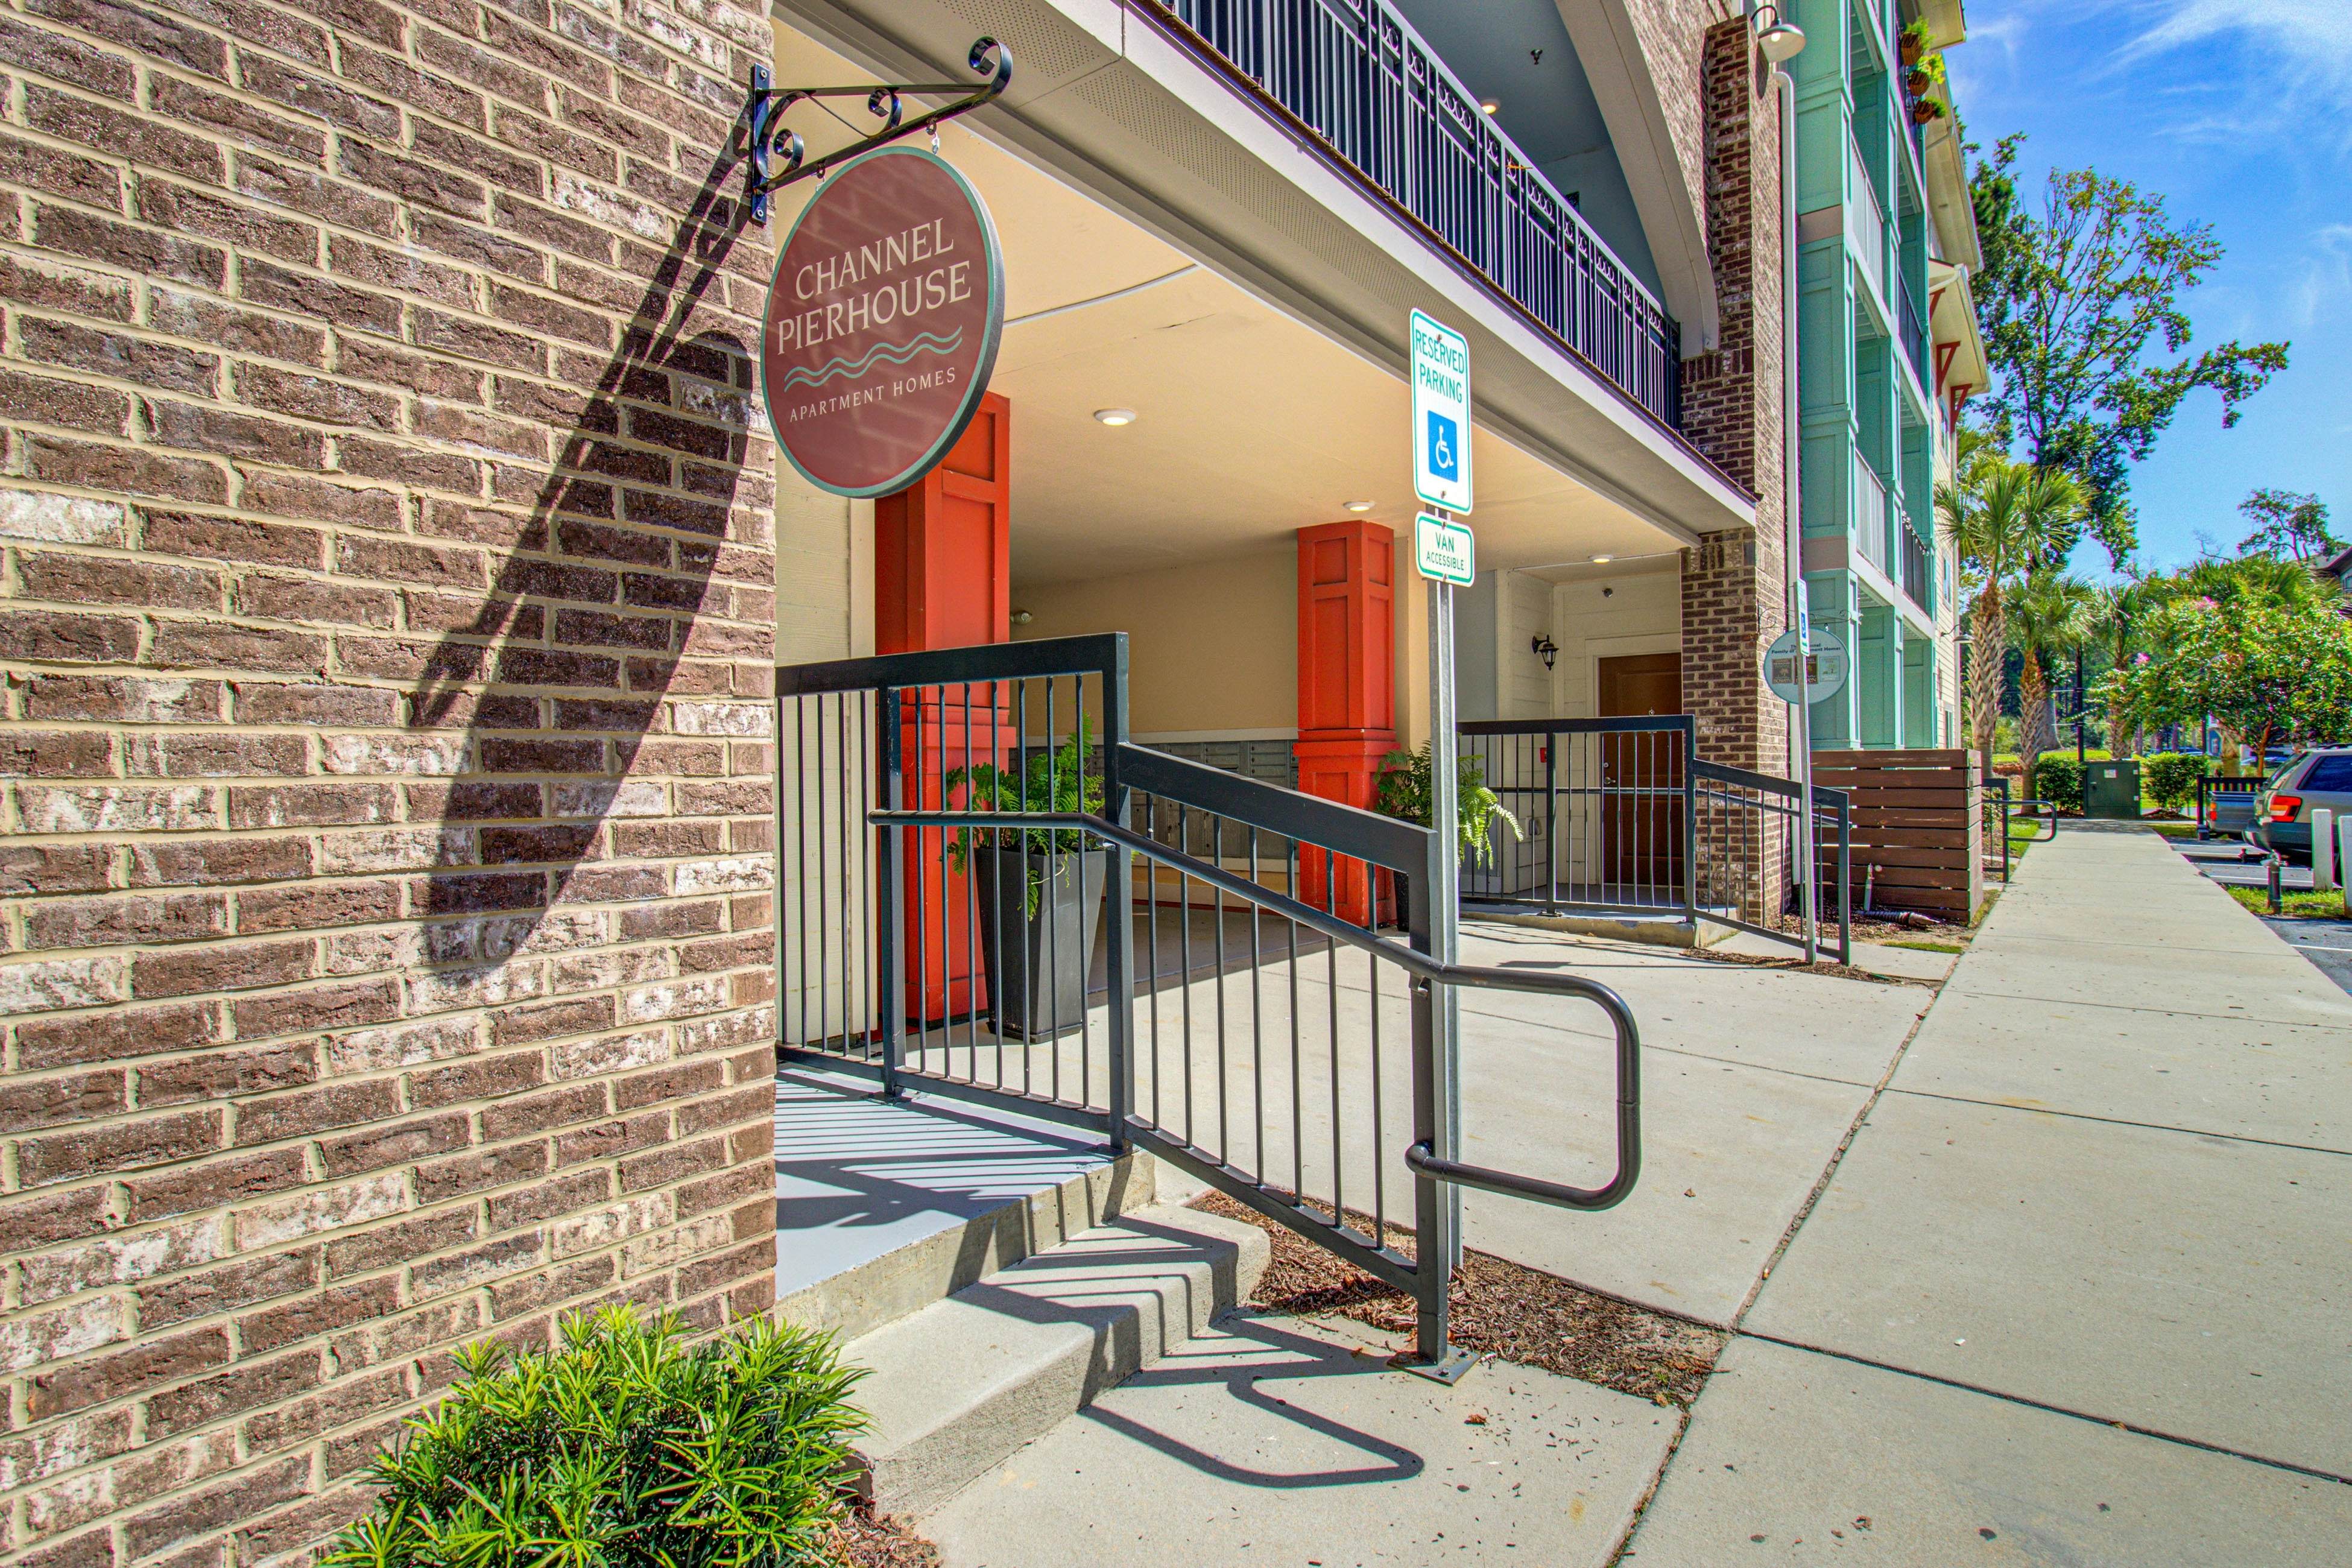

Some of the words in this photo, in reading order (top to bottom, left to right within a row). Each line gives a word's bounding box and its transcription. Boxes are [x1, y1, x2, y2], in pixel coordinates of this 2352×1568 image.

[795, 217, 953, 300] CHANNEL
[777, 260, 972, 356] PIERHOUSE
[1415, 329, 1464, 375] RESERVED
[790, 385, 885, 423] APARTMENT
[893, 367, 956, 397] HOMES
[1420, 365, 1462, 404] PARKING
[1426, 552, 1465, 571] ACCESSIBLE
[1435, 531, 1455, 553] VAN
